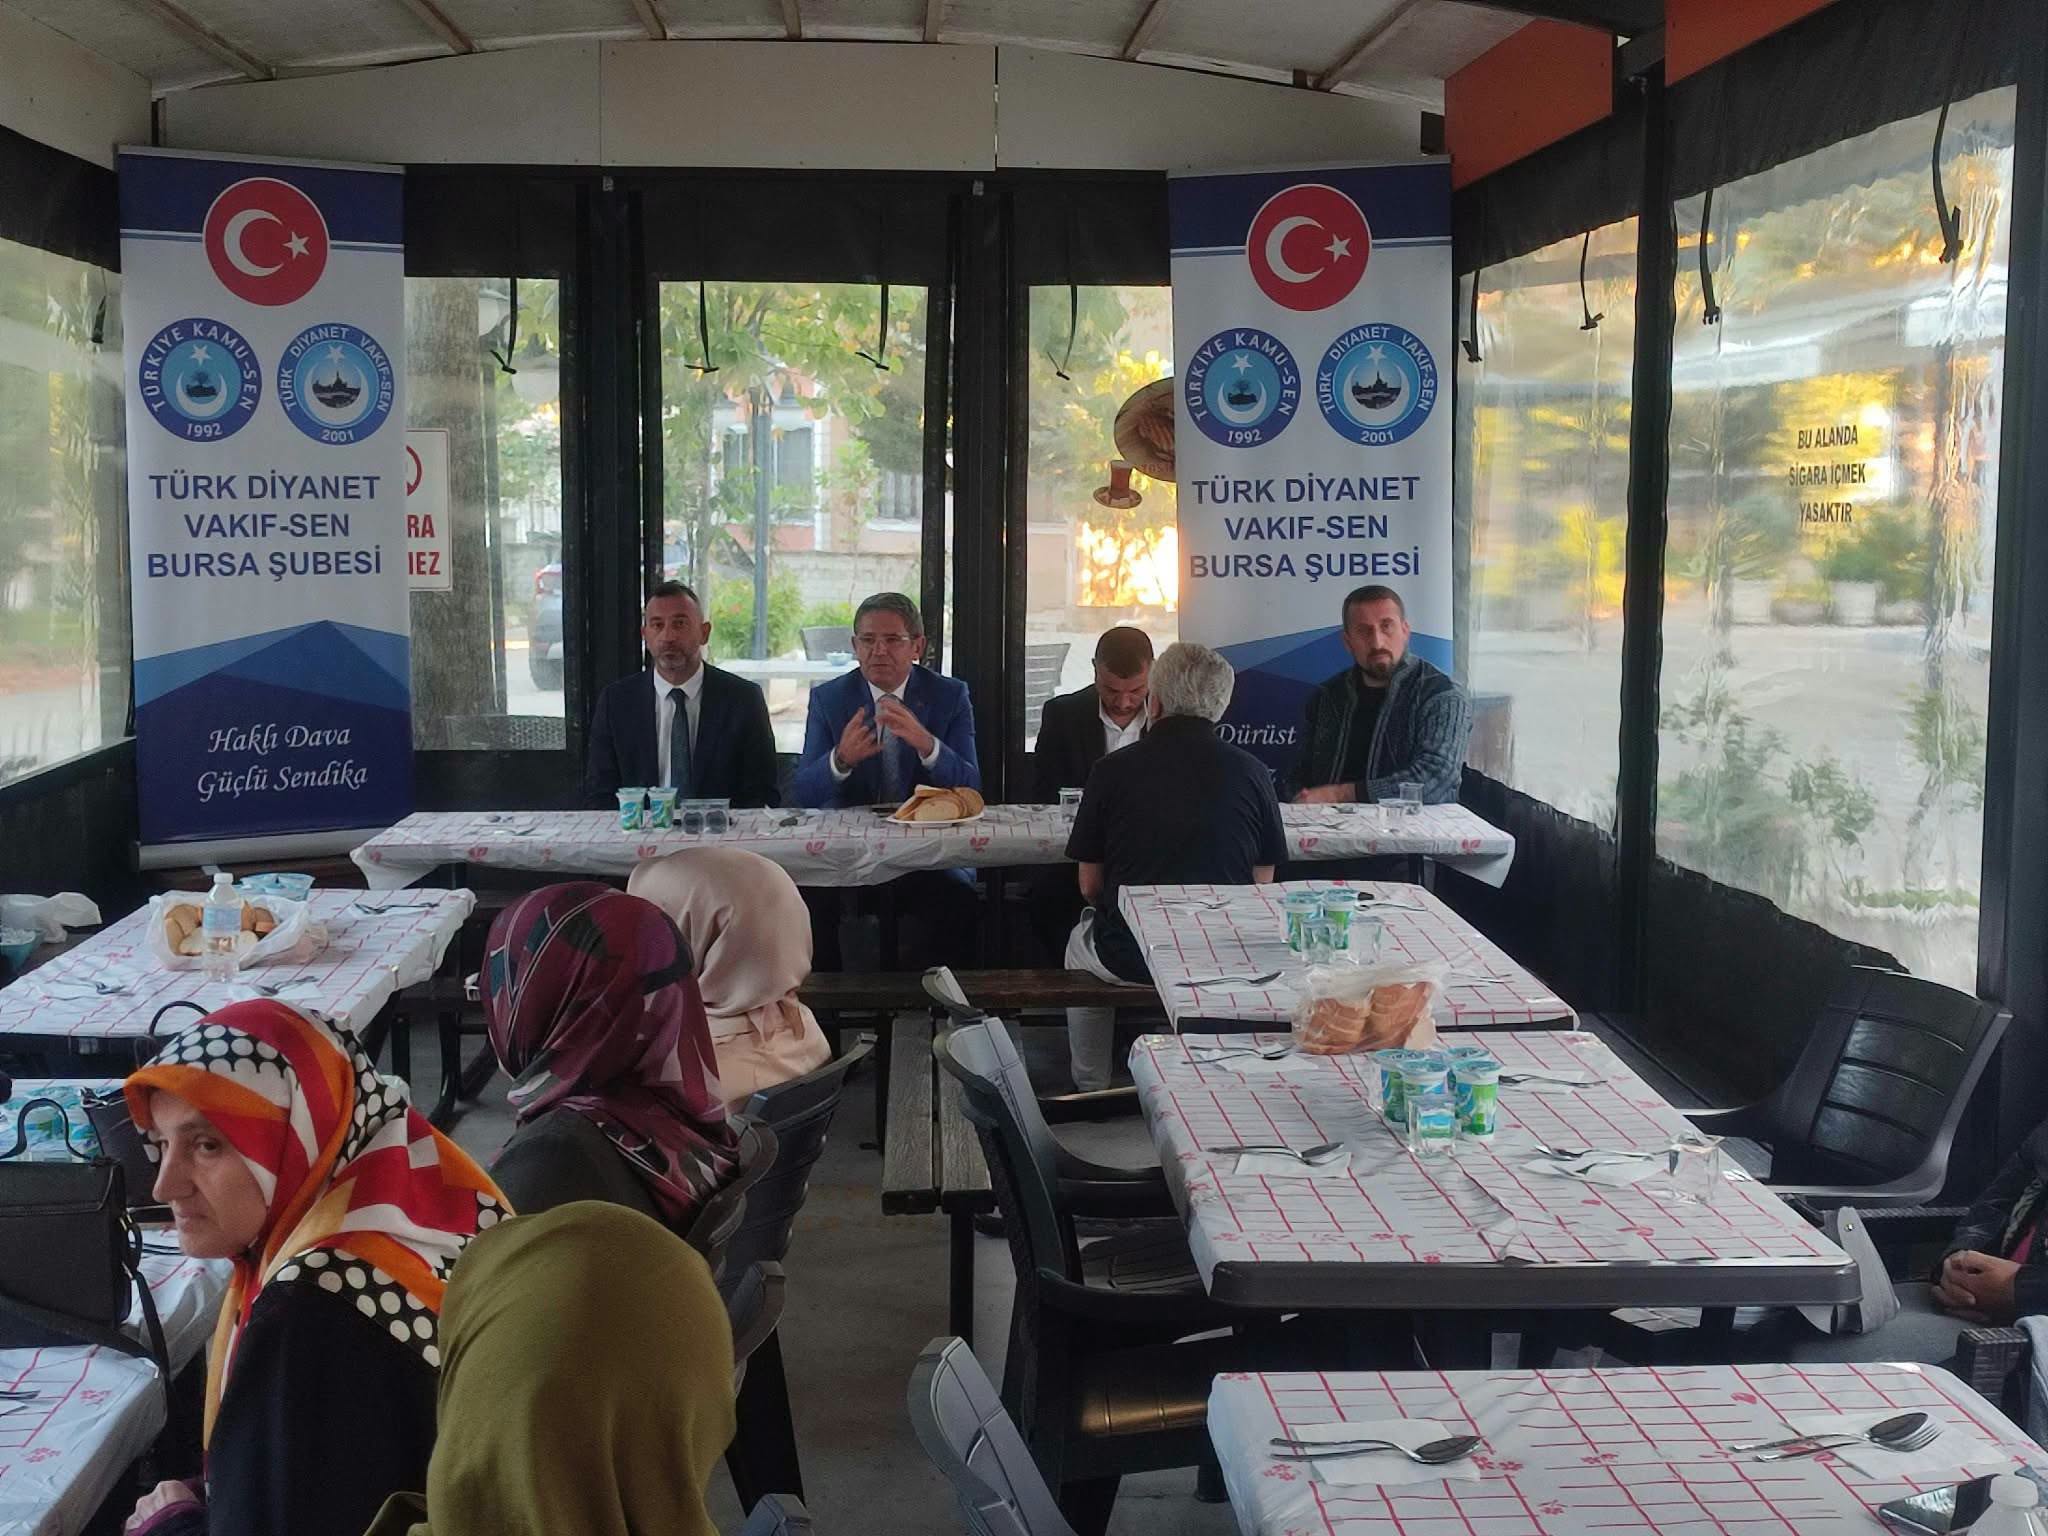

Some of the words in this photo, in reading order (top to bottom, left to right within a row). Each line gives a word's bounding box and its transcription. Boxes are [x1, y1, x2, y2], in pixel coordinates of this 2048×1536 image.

[143, 327, 184, 413] TÜRKİYE
[192, 322, 257, 410] KAMU-SEN
[280, 367, 294, 411] TÜRK
[291, 327, 350, 359] DİYANET
[360, 335, 392, 413] VAKIF-SEN
[1188, 338, 1226, 420] TÜRKİYE
[1235, 332, 1296, 416] KAMU-SEN
[1319, 371, 1333, 415] TÜRK
[1329, 326, 1391, 362] DİYANET
[1401, 333, 1435, 411] VAKIF-SEN
[186, 422, 223, 438] 1992
[321, 429, 355, 443] 2001
[1227, 429, 1263, 444] 1992
[1360, 430, 1395, 444] 2001
[1798, 430, 1813, 449] BU
[1814, 425, 1858, 448] ALANDA
[148, 469, 238, 500] TÜRK
[248, 469, 381, 500] DİYANET
[1191, 475, 1276, 505] TÜRK
[1285, 472, 1420, 503] DİYANET
[1789, 462, 1828, 486] SİGARA
[1830, 460, 1866, 489] İÇMEK
[184, 513, 350, 539] VAKIF-SEN
[1800, 502, 1852, 523] YASAKTIR
[1224, 515, 1388, 541] VAKIF-SEN
[147, 552, 260, 578] BURSA
[268, 545, 381, 582] ŞUBESİ
[1190, 554, 1296, 579] BURSA
[1305, 546, 1420, 583] ŞUBESİ
[207, 723, 277, 756] Haklı
[284, 725, 351, 748] Dava
[1215, 723, 1297, 745] Dürüst
[197, 764, 268, 803] Güçlü
[273, 759, 368, 792] Sendika
